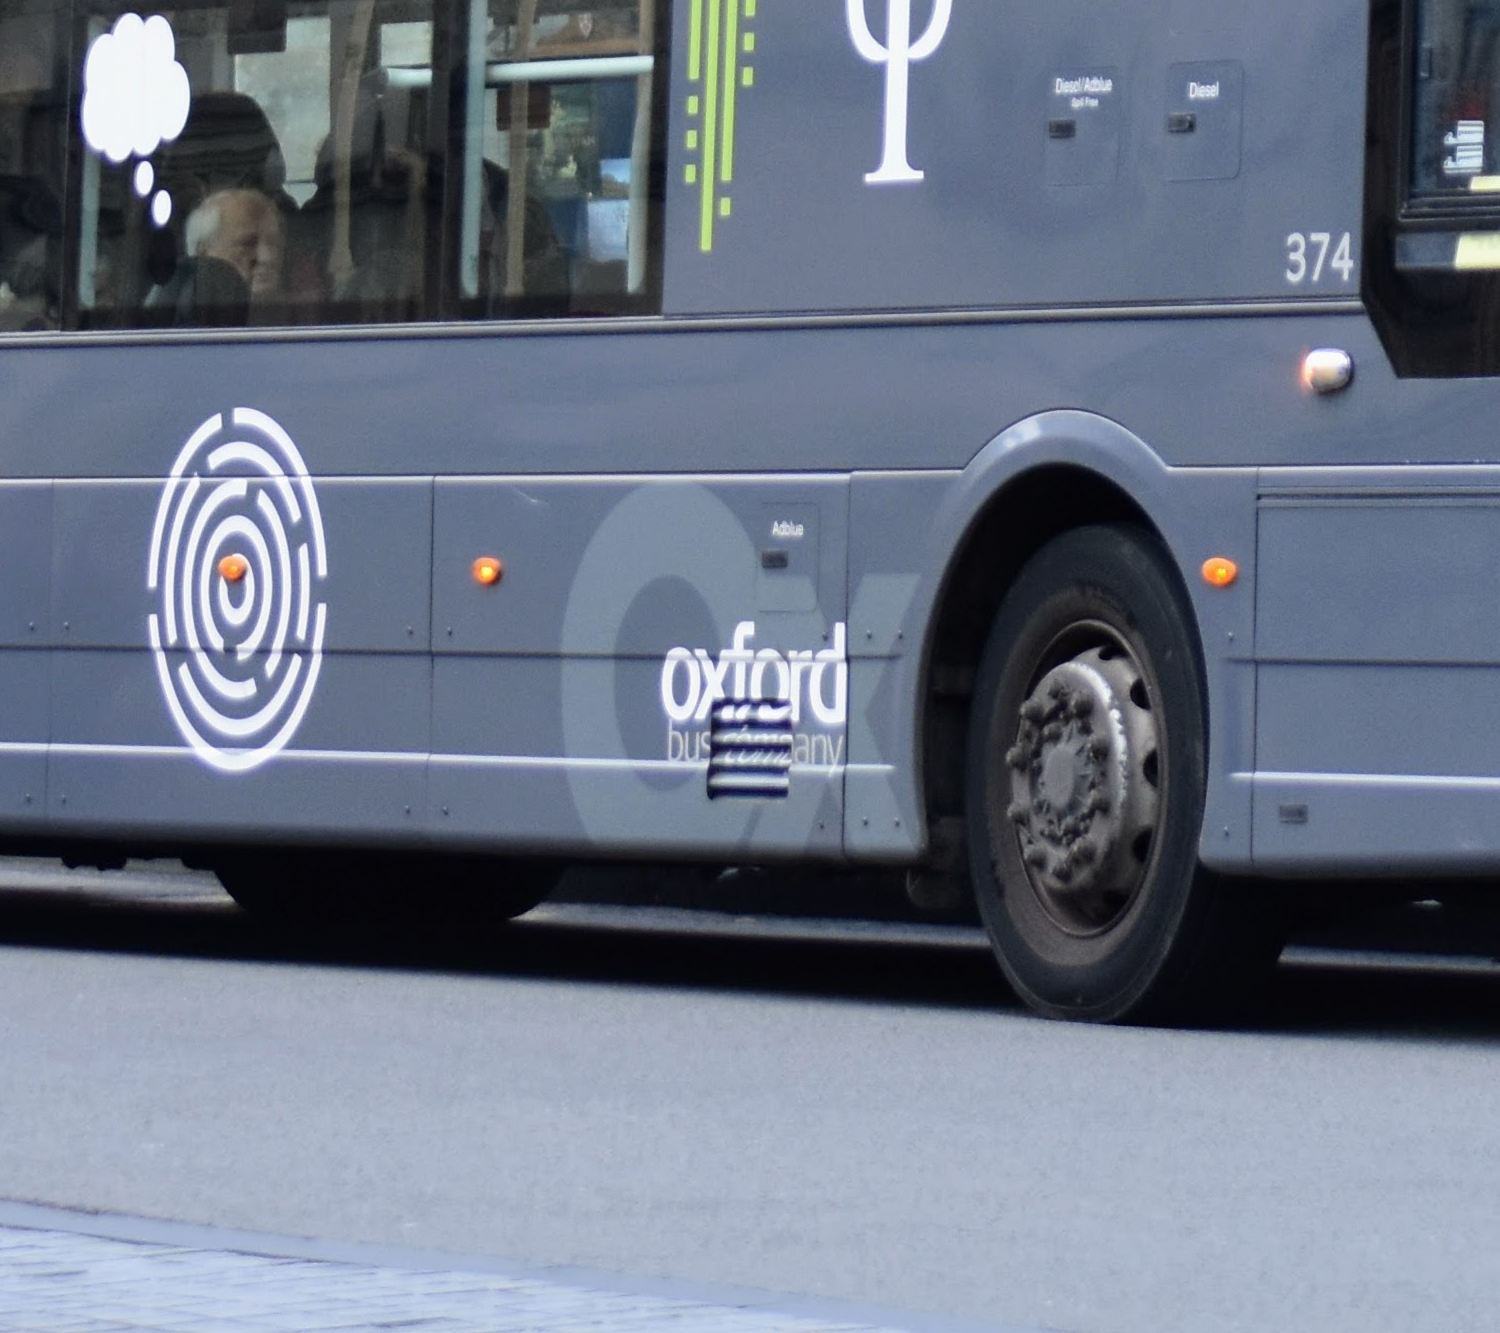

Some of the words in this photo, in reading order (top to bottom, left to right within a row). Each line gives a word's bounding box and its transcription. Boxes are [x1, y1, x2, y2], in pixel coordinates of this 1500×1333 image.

[1189, 80, 1220, 98] Diesel
[1283, 230, 1355, 285] 374
[661, 621, 847, 723] oxford
[667, 718, 712, 764] bus
